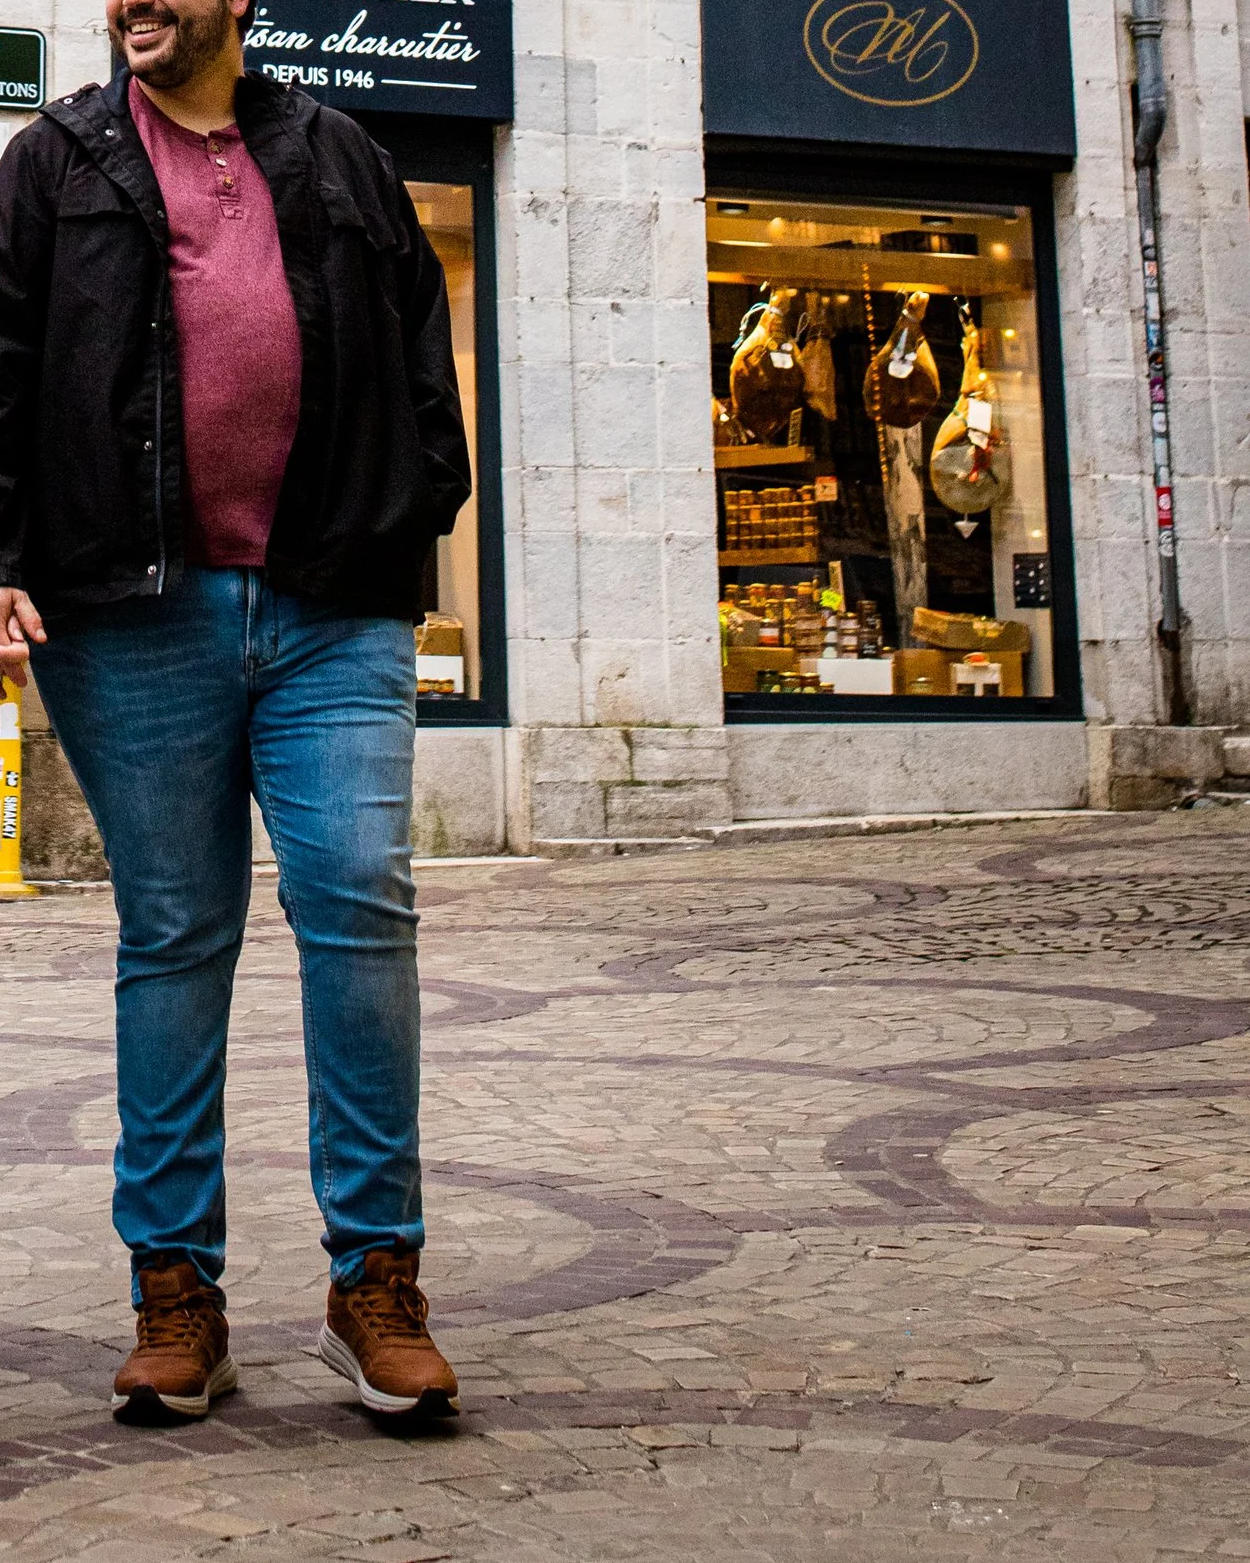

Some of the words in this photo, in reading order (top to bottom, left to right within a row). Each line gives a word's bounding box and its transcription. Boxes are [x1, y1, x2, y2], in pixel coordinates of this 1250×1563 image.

[243, 7, 314, 49] isan
[320, 9, 481, 62] charcutier
[262, 64, 329, 86] DEPUIS
[335, 68, 375, 89] 1946
